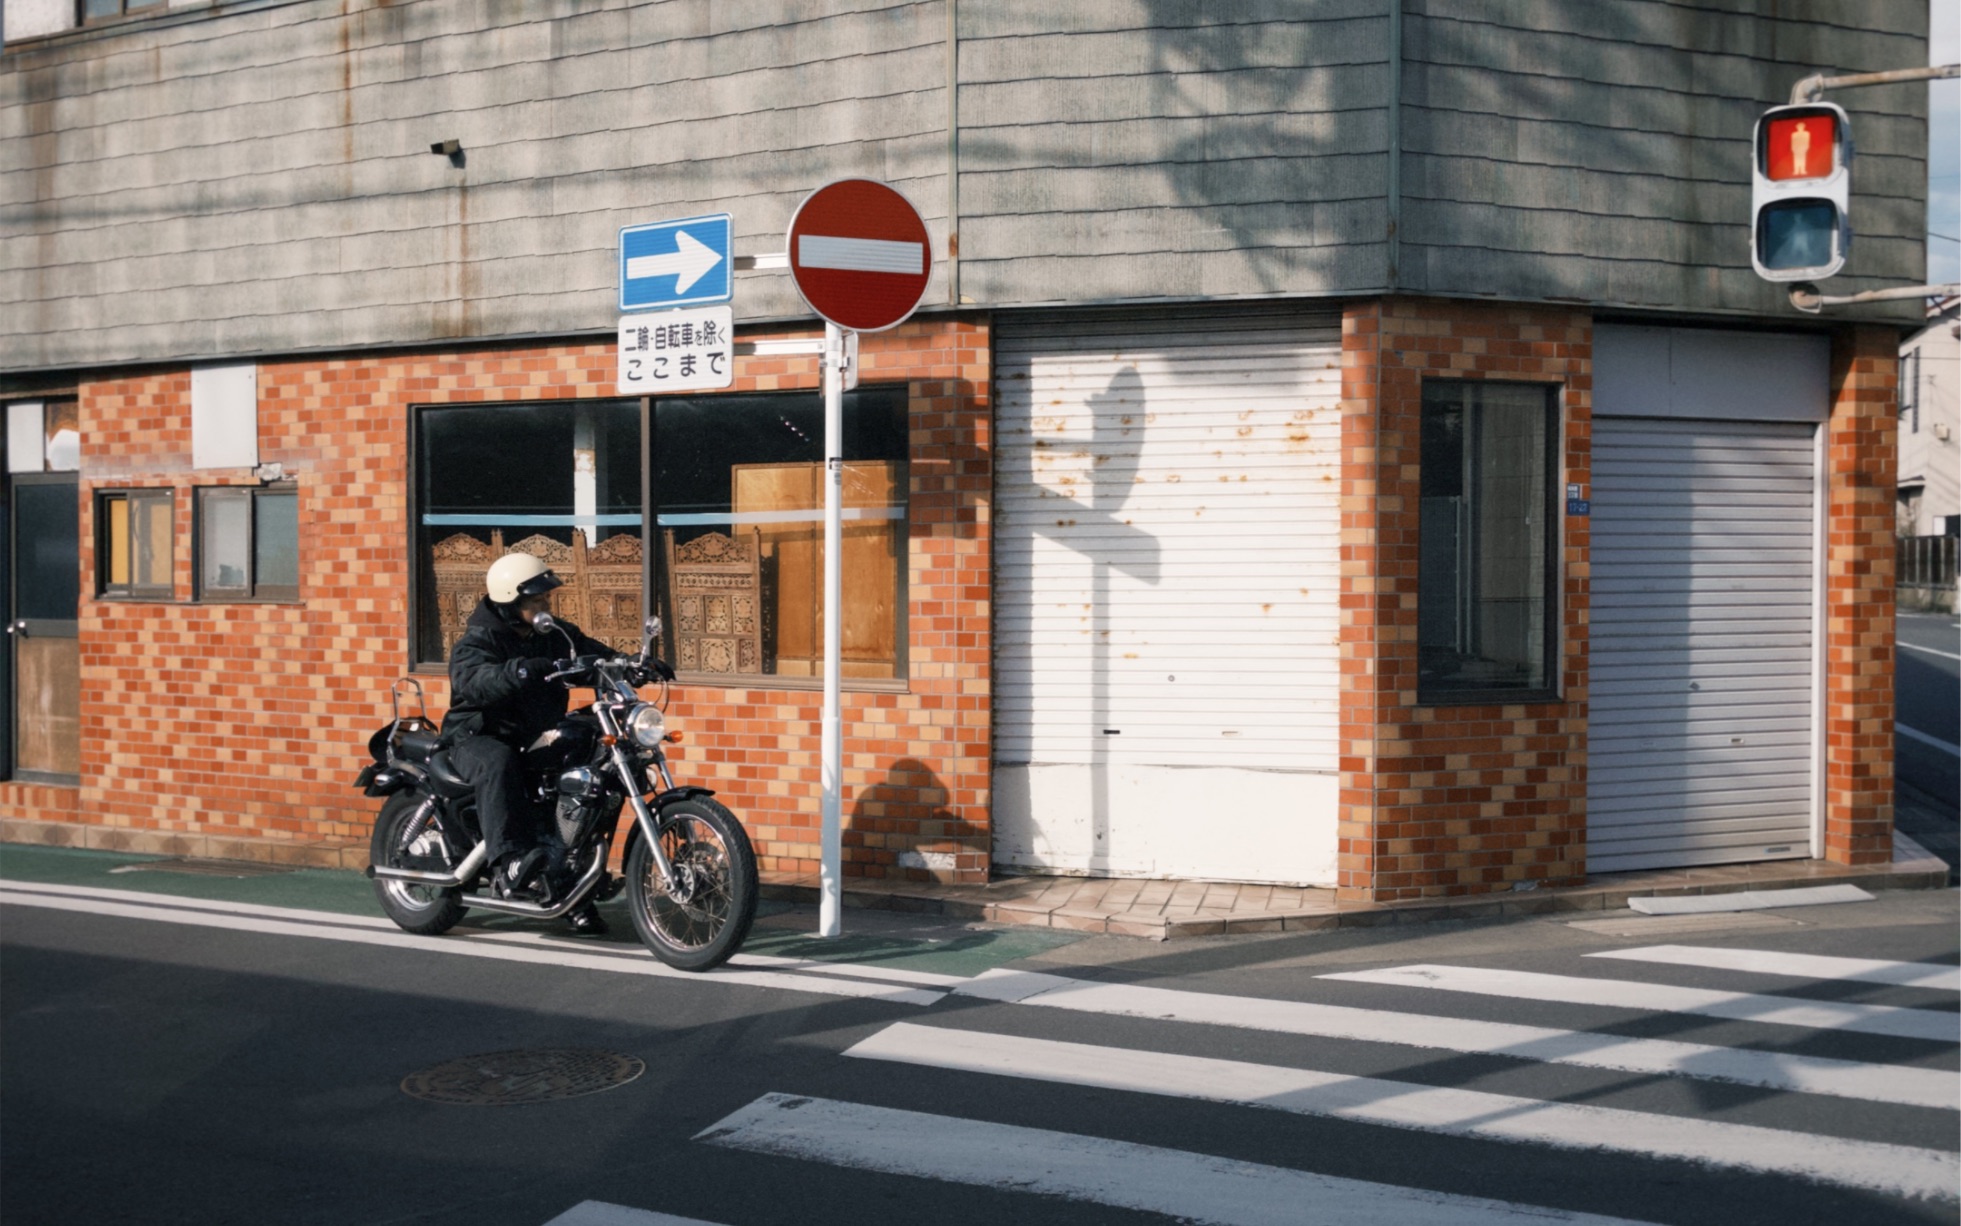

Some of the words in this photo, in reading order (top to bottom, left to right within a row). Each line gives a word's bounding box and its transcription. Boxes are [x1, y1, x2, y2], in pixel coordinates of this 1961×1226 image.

[625, 320, 725, 352] 二輪・自転車を除く
[627, 352, 725, 381] ここまで
